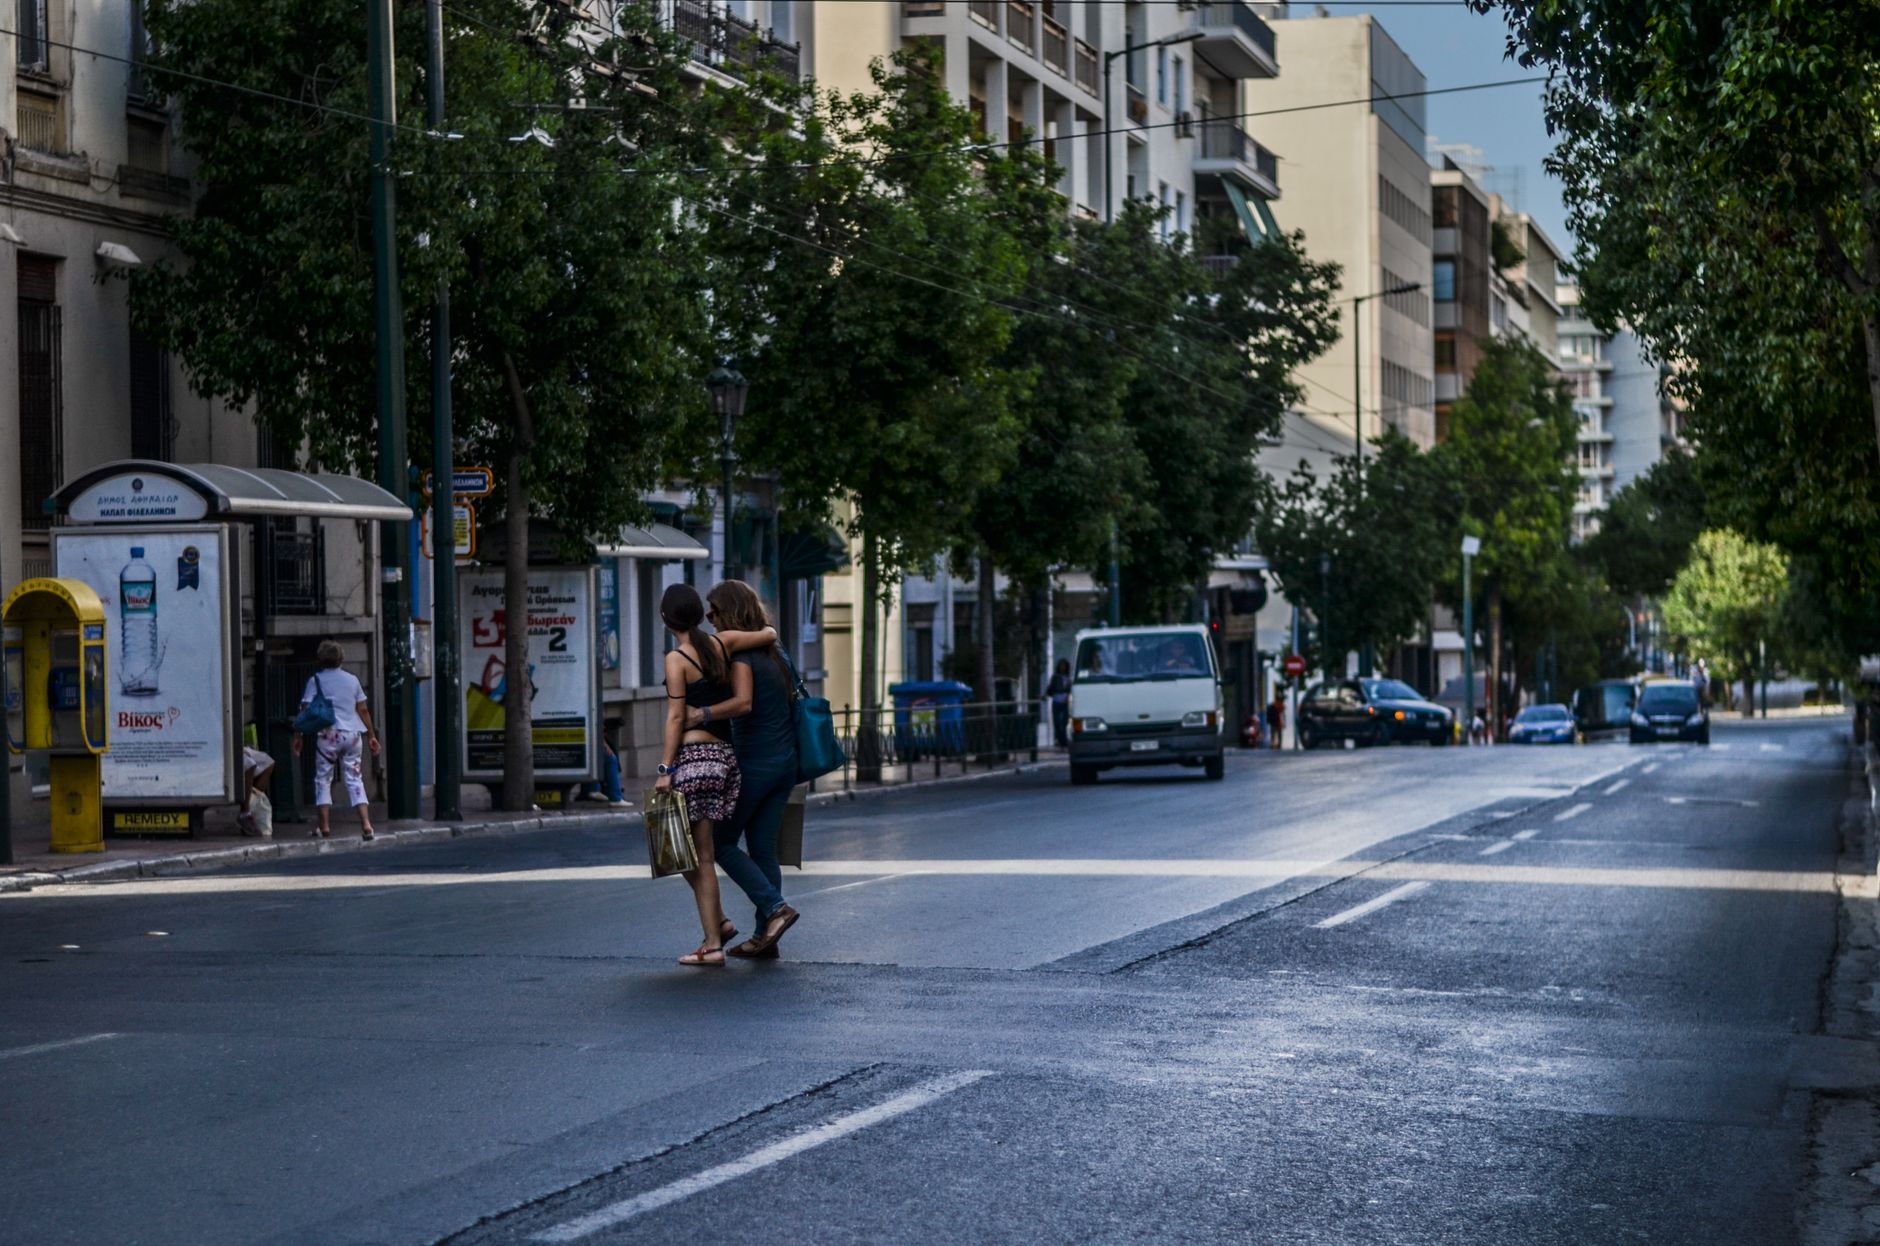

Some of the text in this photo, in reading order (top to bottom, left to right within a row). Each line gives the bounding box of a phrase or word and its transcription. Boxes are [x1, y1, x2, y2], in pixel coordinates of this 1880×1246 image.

[549, 626, 567, 652] 2
[118, 711, 163, 730] Βίκος
[124, 814, 180, 825] REMEDY
